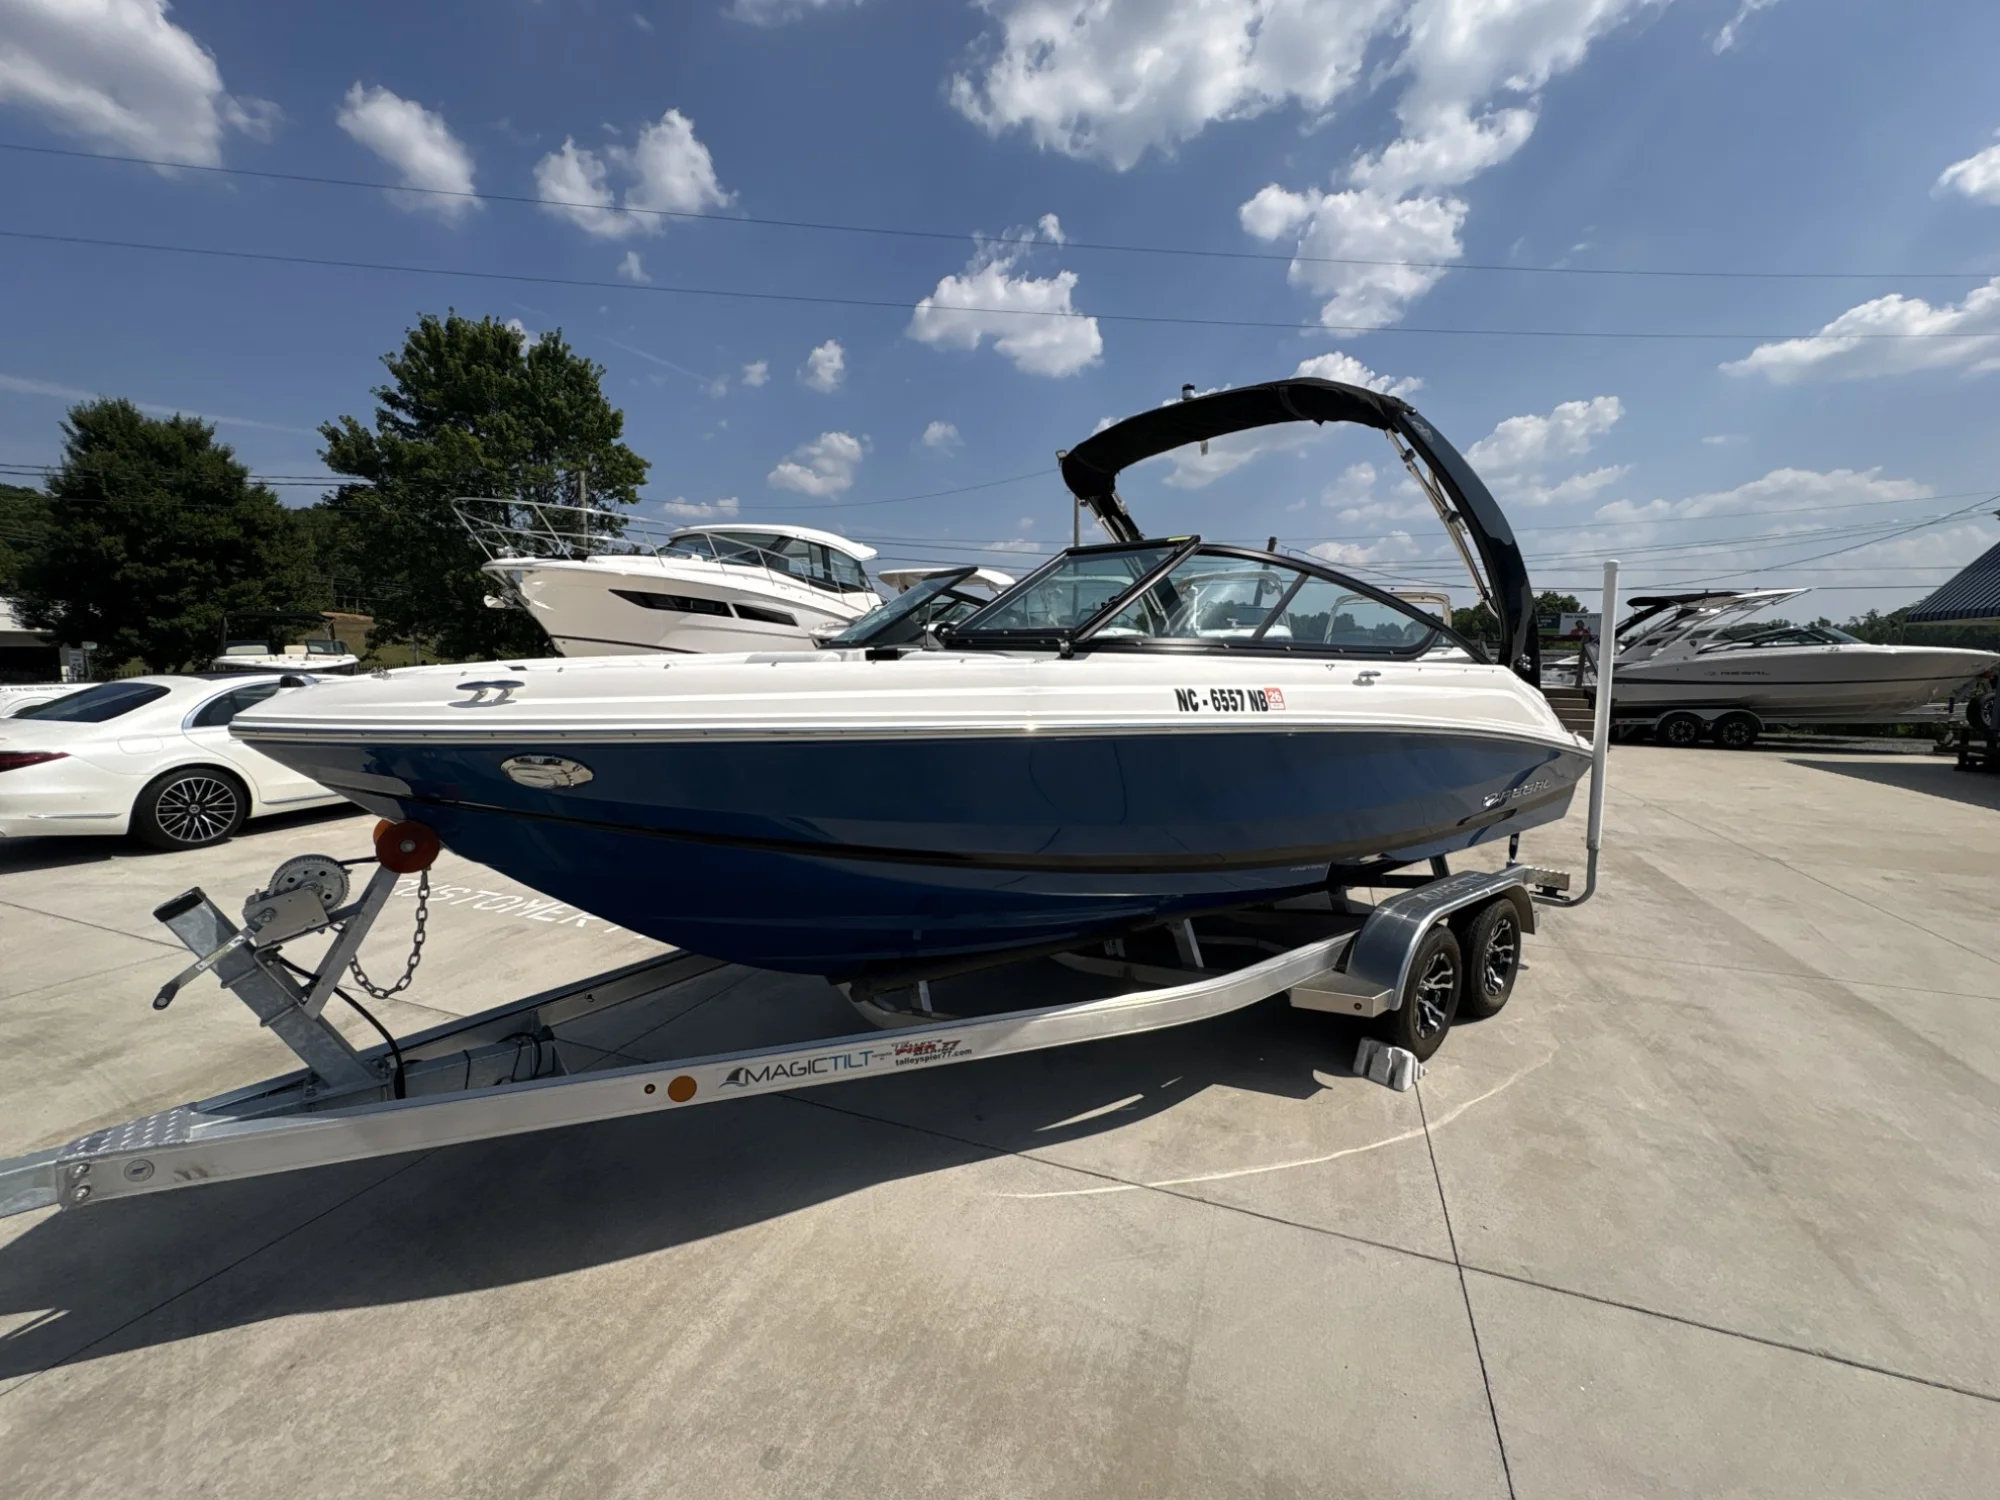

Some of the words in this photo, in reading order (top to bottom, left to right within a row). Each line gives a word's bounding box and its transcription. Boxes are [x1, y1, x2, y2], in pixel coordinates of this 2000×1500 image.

[1174, 688, 1199, 712] NC
[1210, 688, 1244, 712] 6557
[1246, 689, 1268, 712] NB
[1267, 690, 1281, 702] 26
[745, 1050, 874, 1084] MAGICTILT
[895, 1047, 973, 1066] talleyspier77.com
